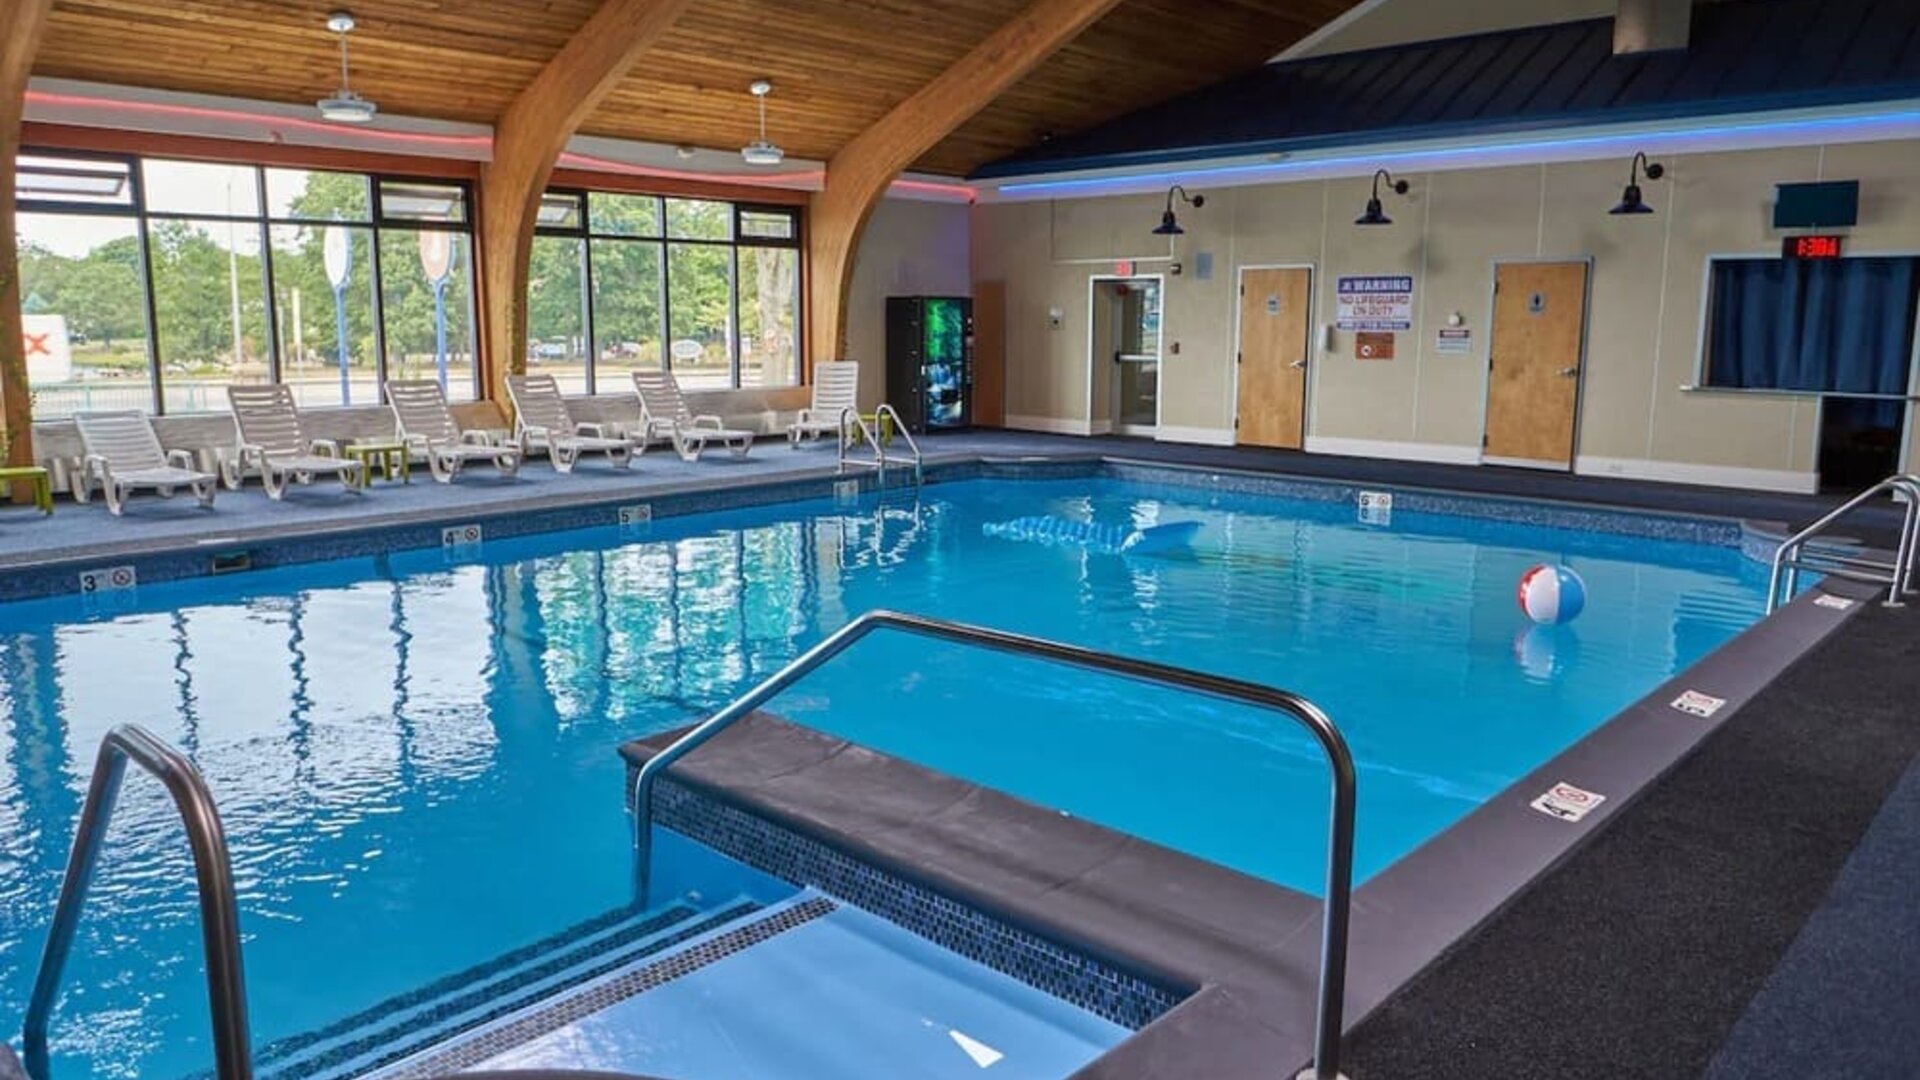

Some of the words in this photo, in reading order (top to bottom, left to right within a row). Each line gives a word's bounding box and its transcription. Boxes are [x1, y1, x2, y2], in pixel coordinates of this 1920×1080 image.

[1353, 279, 1410, 291] WARNING
[1341, 295, 1353, 305] NO
[1355, 294, 1409, 305] LIFEGUARD
[1369, 305, 1393, 316] DUTY
[84, 575, 96, 592] 3
